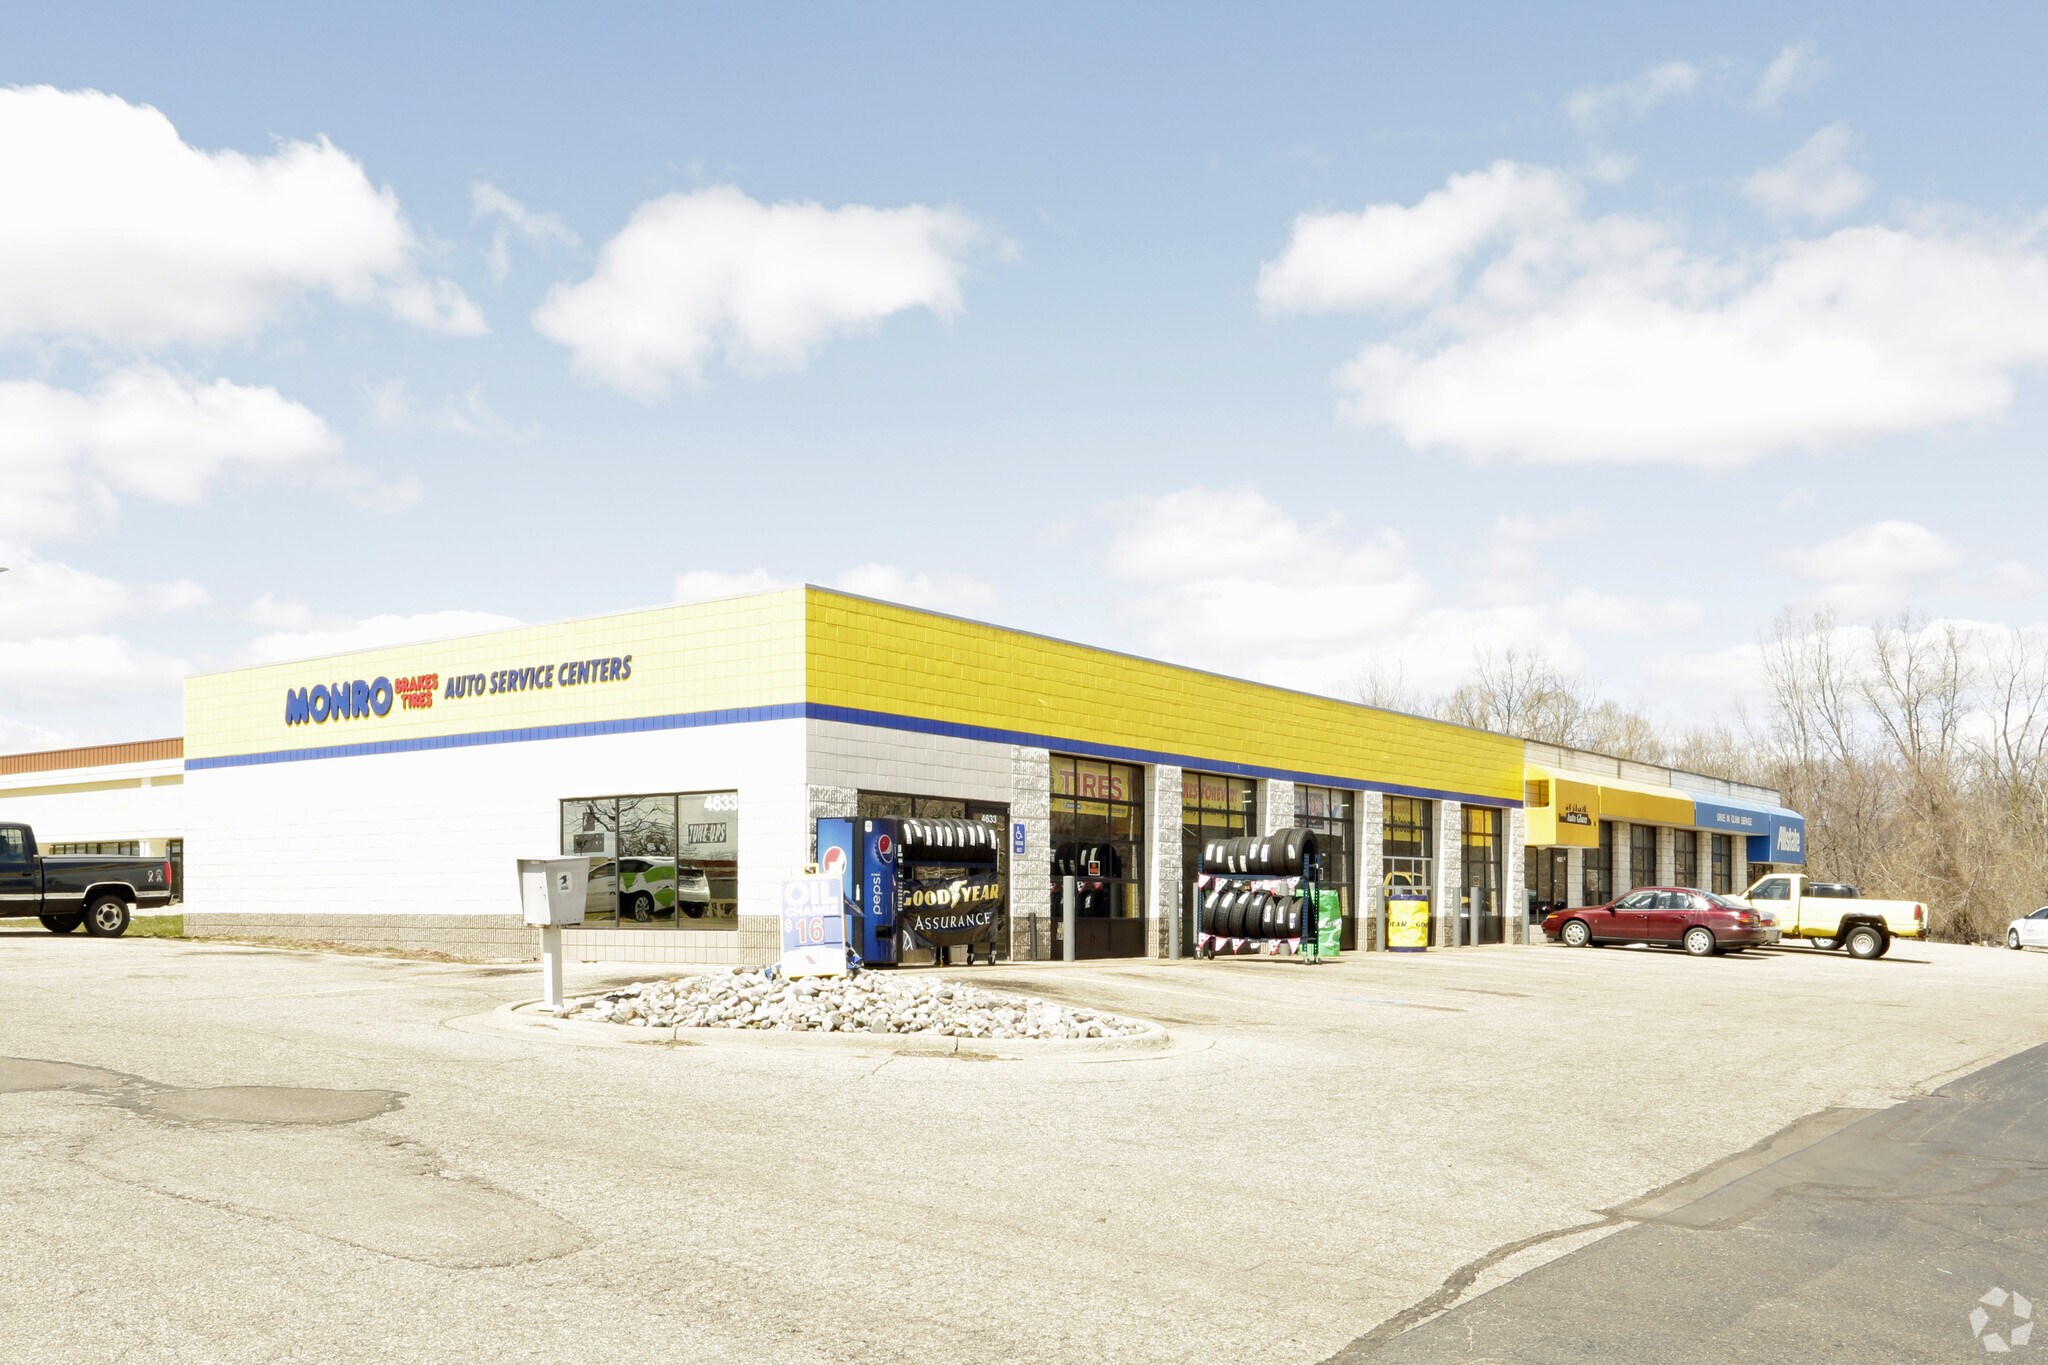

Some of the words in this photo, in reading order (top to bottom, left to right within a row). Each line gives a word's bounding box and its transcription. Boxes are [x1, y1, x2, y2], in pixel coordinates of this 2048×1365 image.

[395, 673, 439, 693] BRAKES
[444, 673, 486, 699] AUTO
[489, 665, 555, 694] SERVICE
[558, 655, 633, 687] CENTERS
[285, 676, 393, 726] MONRO
[400, 691, 433, 710] TIRES
[1060, 770, 1123, 801] TIRES
[703, 794, 739, 811] 4633
[981, 814, 997, 824] 4633
[1777, 826, 1801, 853] Allstate
[784, 881, 839, 907] OIL
[871, 872, 883, 915] pepsi
[785, 904, 839, 917] CHANGE
[914, 913, 991, 931] ASSURANCE
